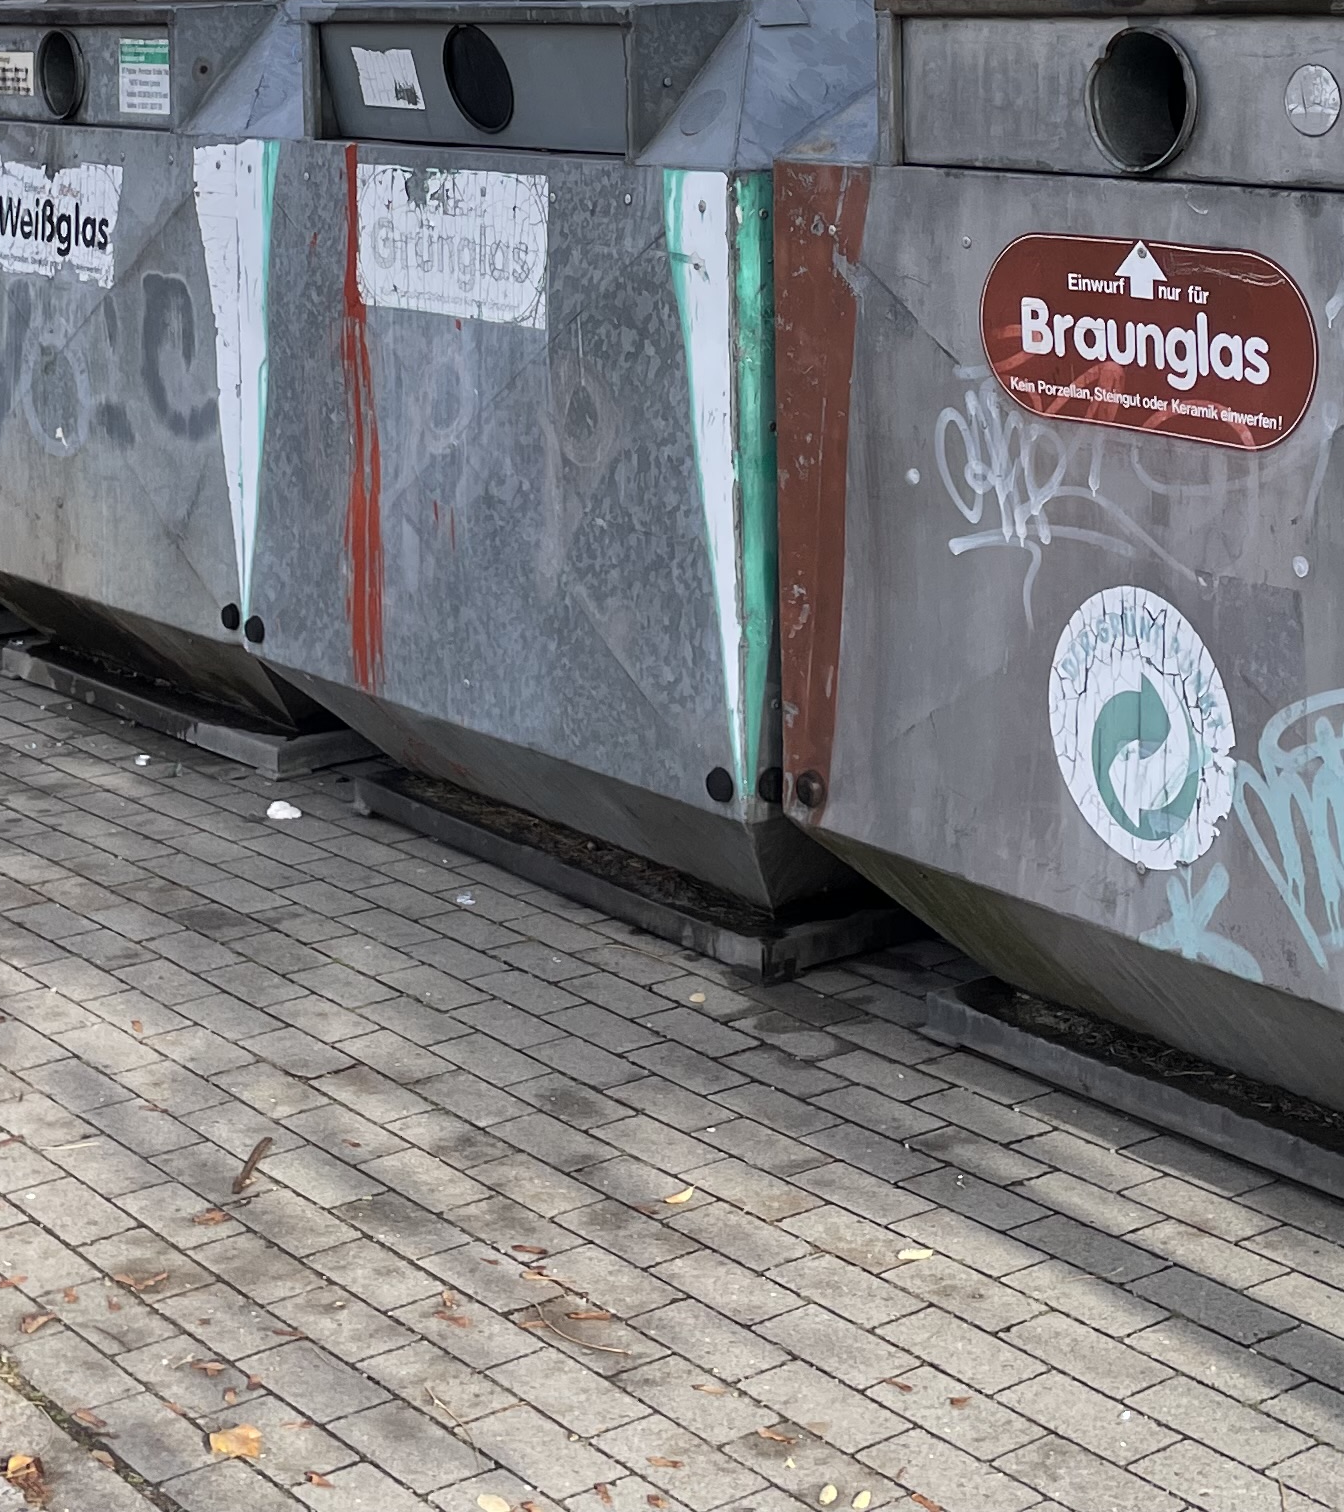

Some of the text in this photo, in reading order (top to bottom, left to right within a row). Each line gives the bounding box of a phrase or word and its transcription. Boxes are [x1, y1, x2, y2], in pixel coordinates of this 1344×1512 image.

[1067, 272, 1209, 304] Einwurf nur für
[1020, 297, 1270, 391] Braunglas
[1010, 376, 1283, 431] Kein Porzellan, Steingut oder Keramik einwerfen!
